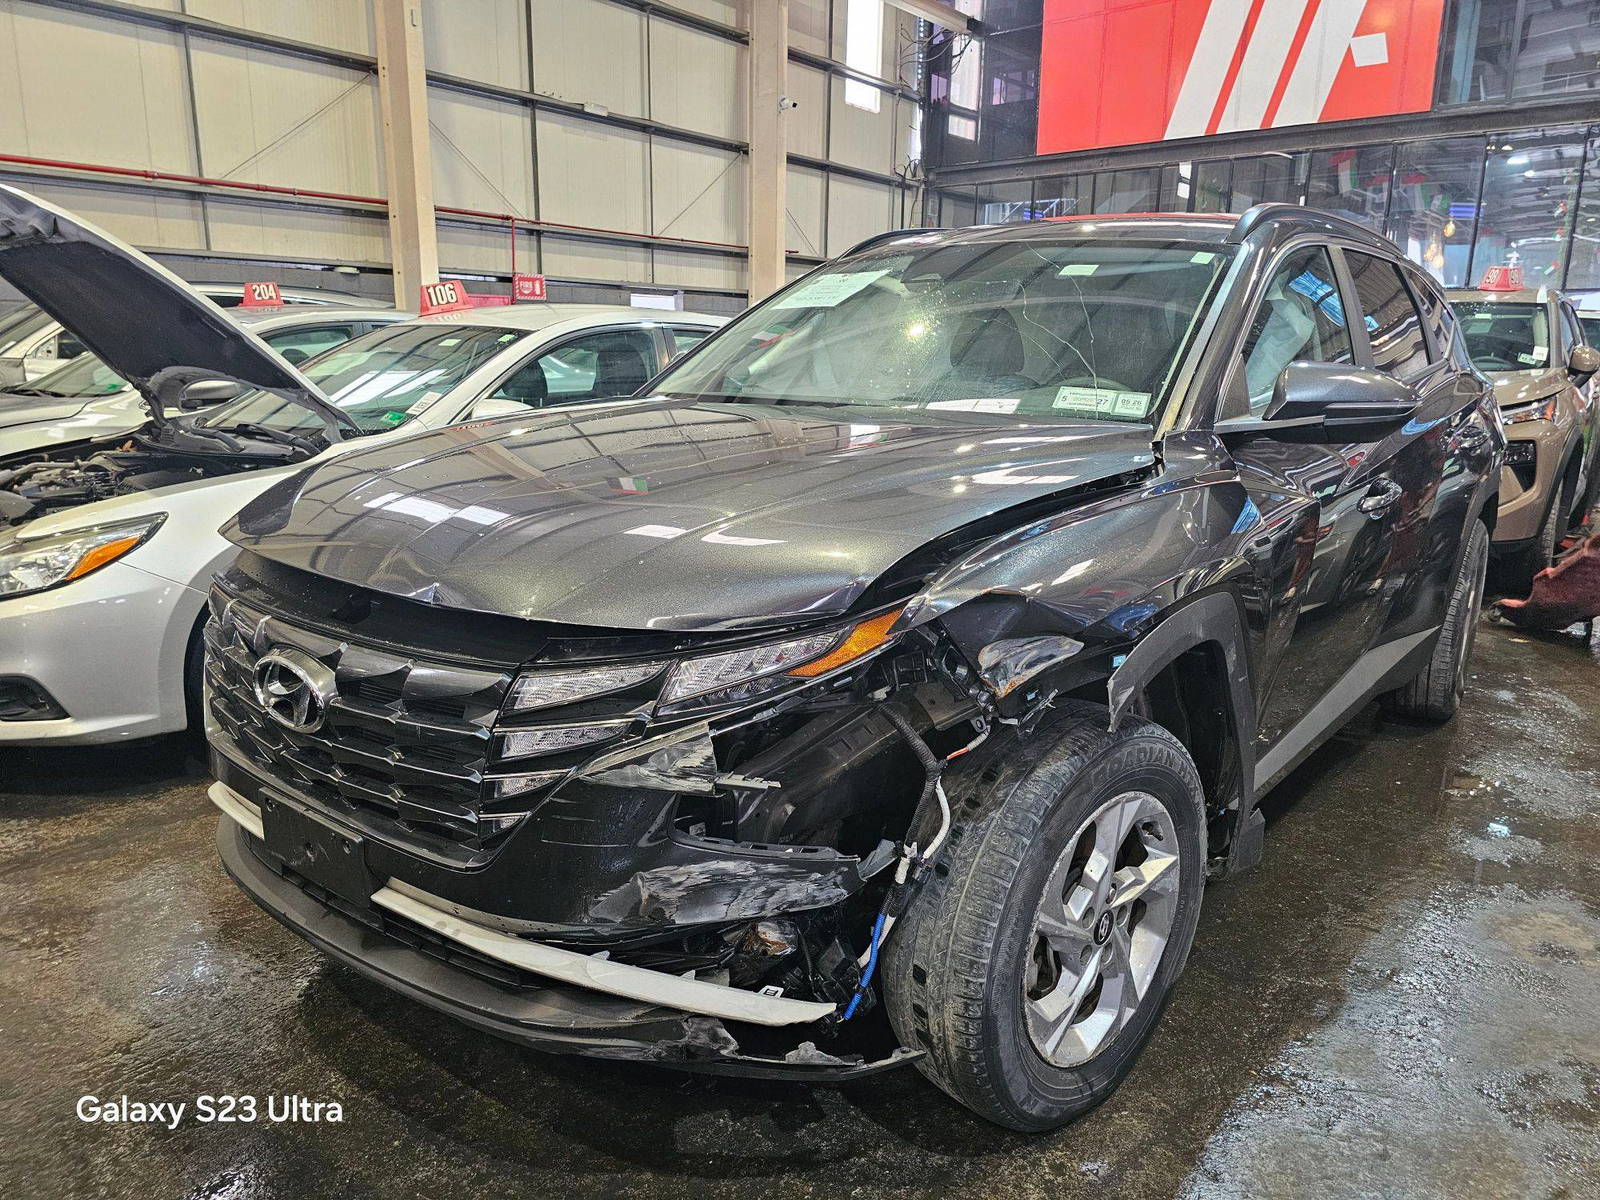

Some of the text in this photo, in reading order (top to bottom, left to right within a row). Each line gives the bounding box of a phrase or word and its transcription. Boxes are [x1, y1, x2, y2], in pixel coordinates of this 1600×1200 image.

[252, 284, 277, 300] 204
[427, 283, 458, 307] 106
[1096, 398, 1109, 406] 27
